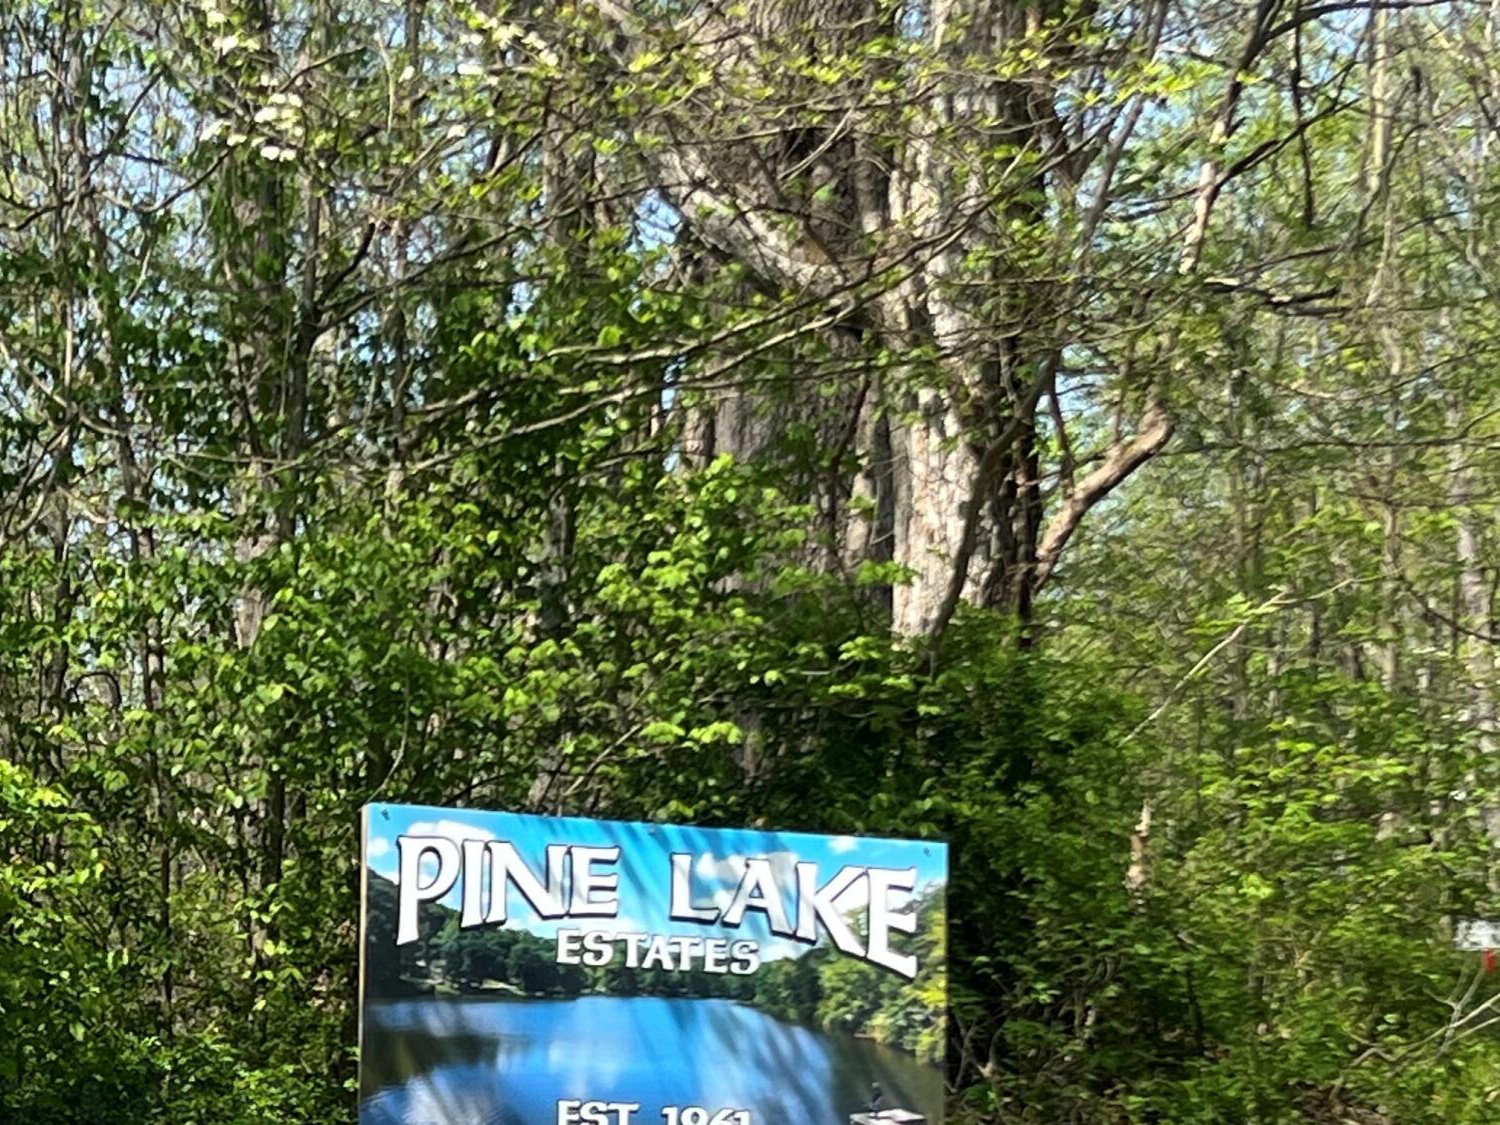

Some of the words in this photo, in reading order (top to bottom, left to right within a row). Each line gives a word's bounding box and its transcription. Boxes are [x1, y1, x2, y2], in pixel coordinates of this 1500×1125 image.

[396, 833, 620, 946] PINE
[669, 851, 919, 980] LAKE
[555, 928, 760, 976] ESTATES
